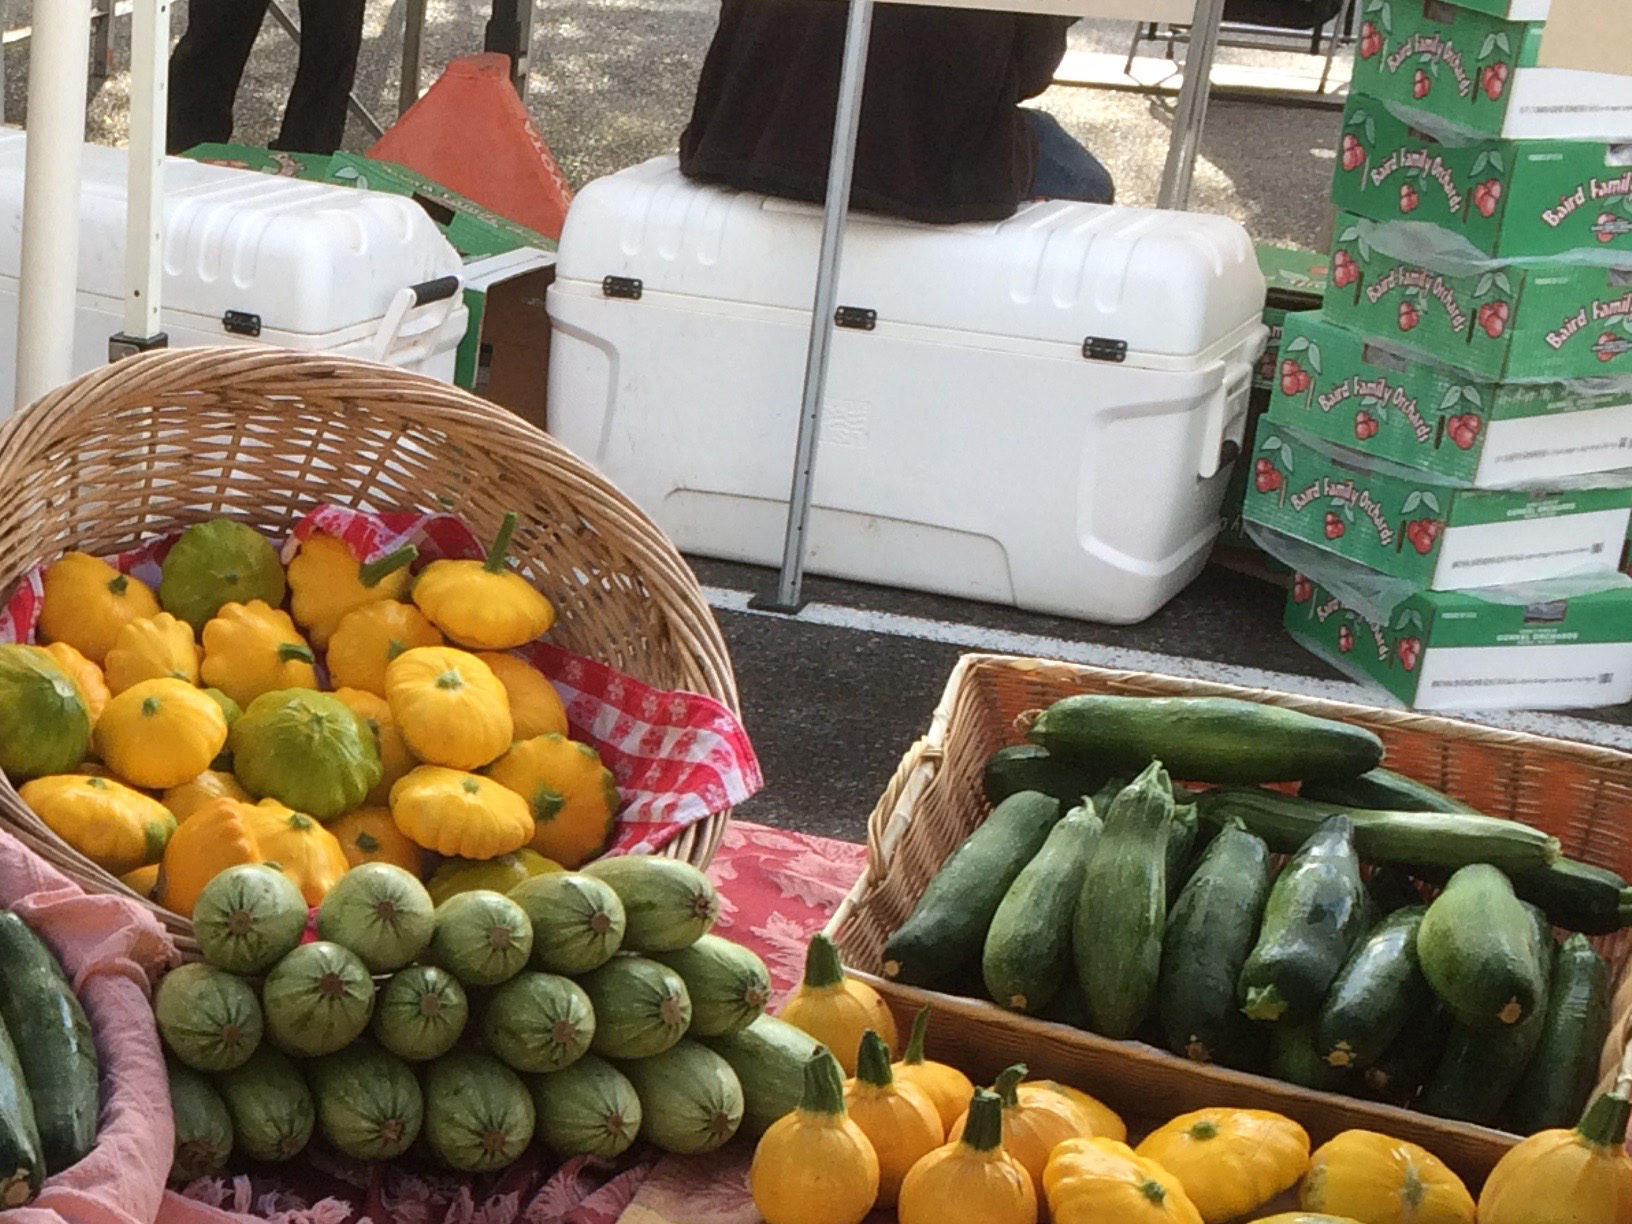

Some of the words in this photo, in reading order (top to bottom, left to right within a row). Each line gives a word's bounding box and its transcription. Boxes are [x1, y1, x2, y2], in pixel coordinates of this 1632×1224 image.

[1542, 186, 1586, 227] Baird
[1590, 171, 1632, 199] Famil
[1366, 270, 1396, 303] Baird
[1398, 266, 1433, 298] Family
[1433, 277, 1466, 333] Orchards
[1545, 308, 1588, 349] Baird
[1592, 293, 1632, 320] Famil
[1318, 380, 1350, 412] Baird
[1353, 376, 1393, 408] Family
[1391, 387, 1431, 442] Orchards
[1290, 480, 1321, 511] Baird
[1323, 477, 1359, 509] Family
[1359, 490, 1394, 545] Orchards
